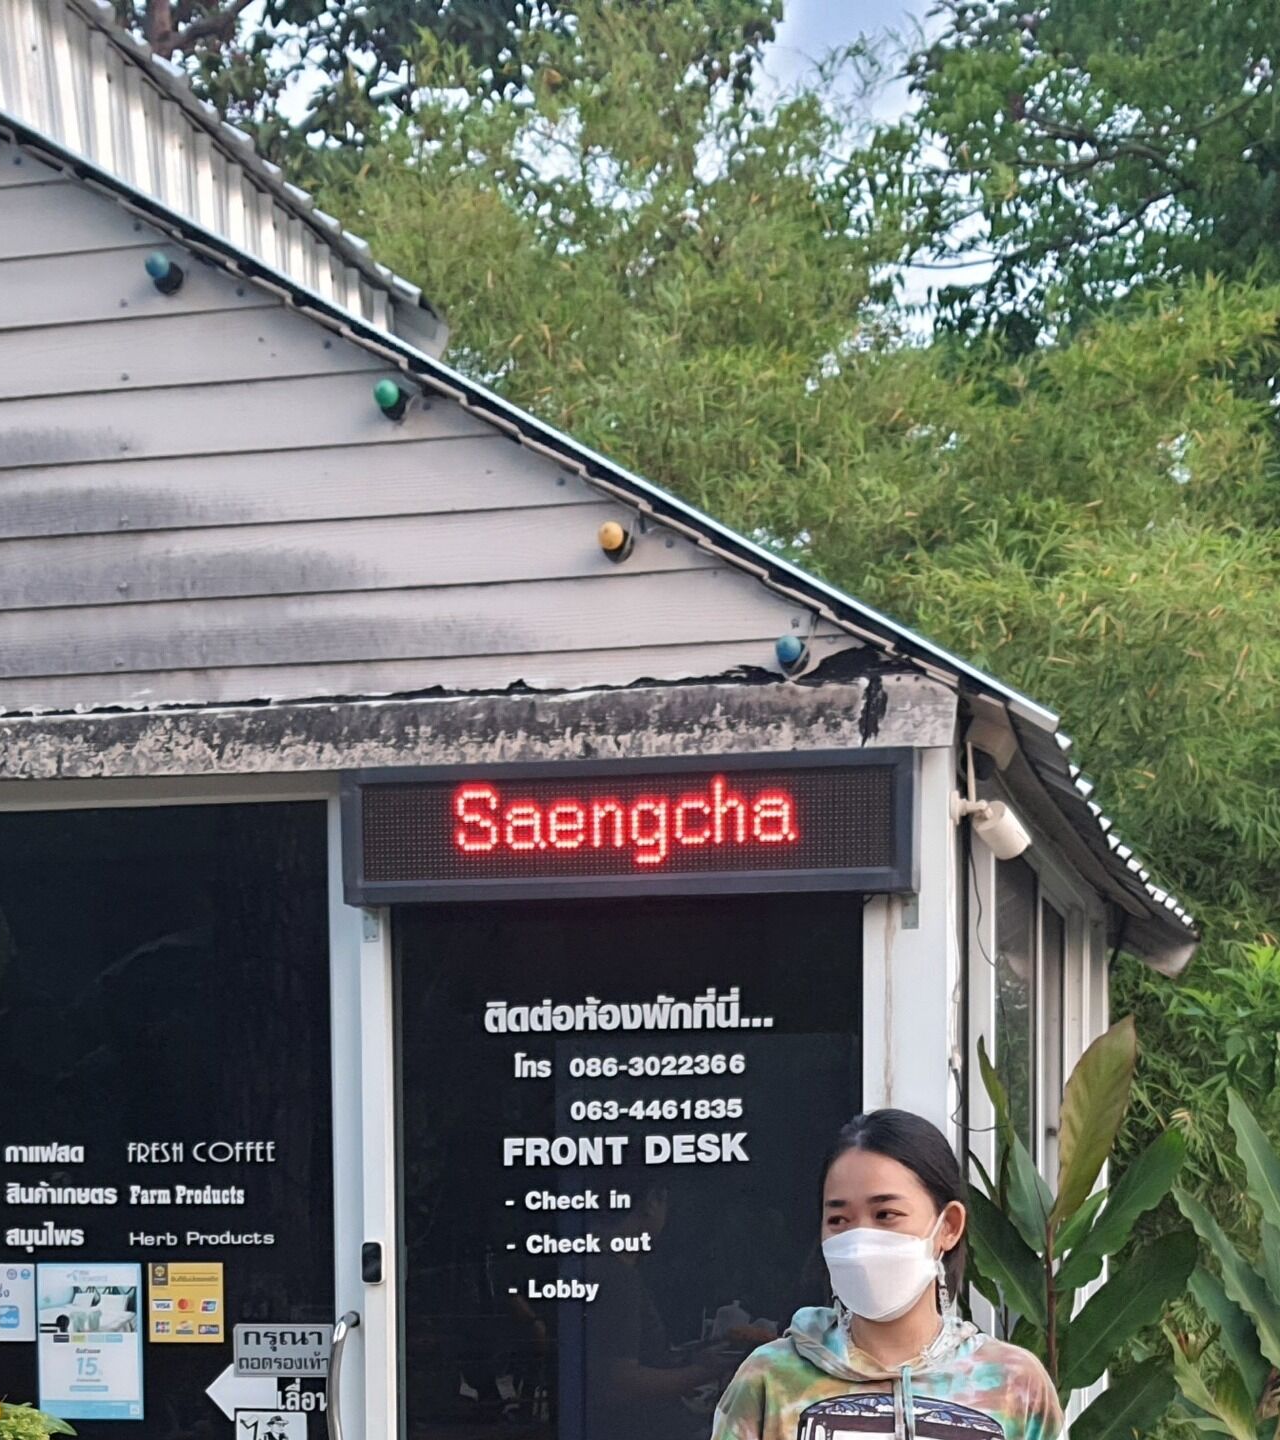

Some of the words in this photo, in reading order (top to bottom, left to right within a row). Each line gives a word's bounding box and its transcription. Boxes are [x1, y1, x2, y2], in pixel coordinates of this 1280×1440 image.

[456, 775, 798, 864] Saengcha
[569, 1054, 746, 1078] 086-3022366
[570, 1098, 743, 1121] 063-4461835
[5, 1142, 85, 1163] กาแฟสด
[127, 1142, 184, 1163] FRESH
[192, 1141, 276, 1163] COFFEE
[503, 1136, 629, 1166] FRONT
[645, 1132, 750, 1164] DESK
[6, 1181, 118, 1205] สินค้าเกษตร
[129, 1185, 171, 1205] Farm
[175, 1185, 245, 1205] Products
[525, 1190, 600, 1210] Check
[610, 1190, 631, 1209] in
[6, 1221, 85, 1253] สมุนไพร
[129, 1231, 178, 1246] Herb
[186, 1230, 275, 1246] Products
[526, 1233, 601, 1254] Check
[610, 1232, 651, 1251] out
[528, 1279, 599, 1302] Lobby
[244, 1331, 322, 1352] กรุณา
